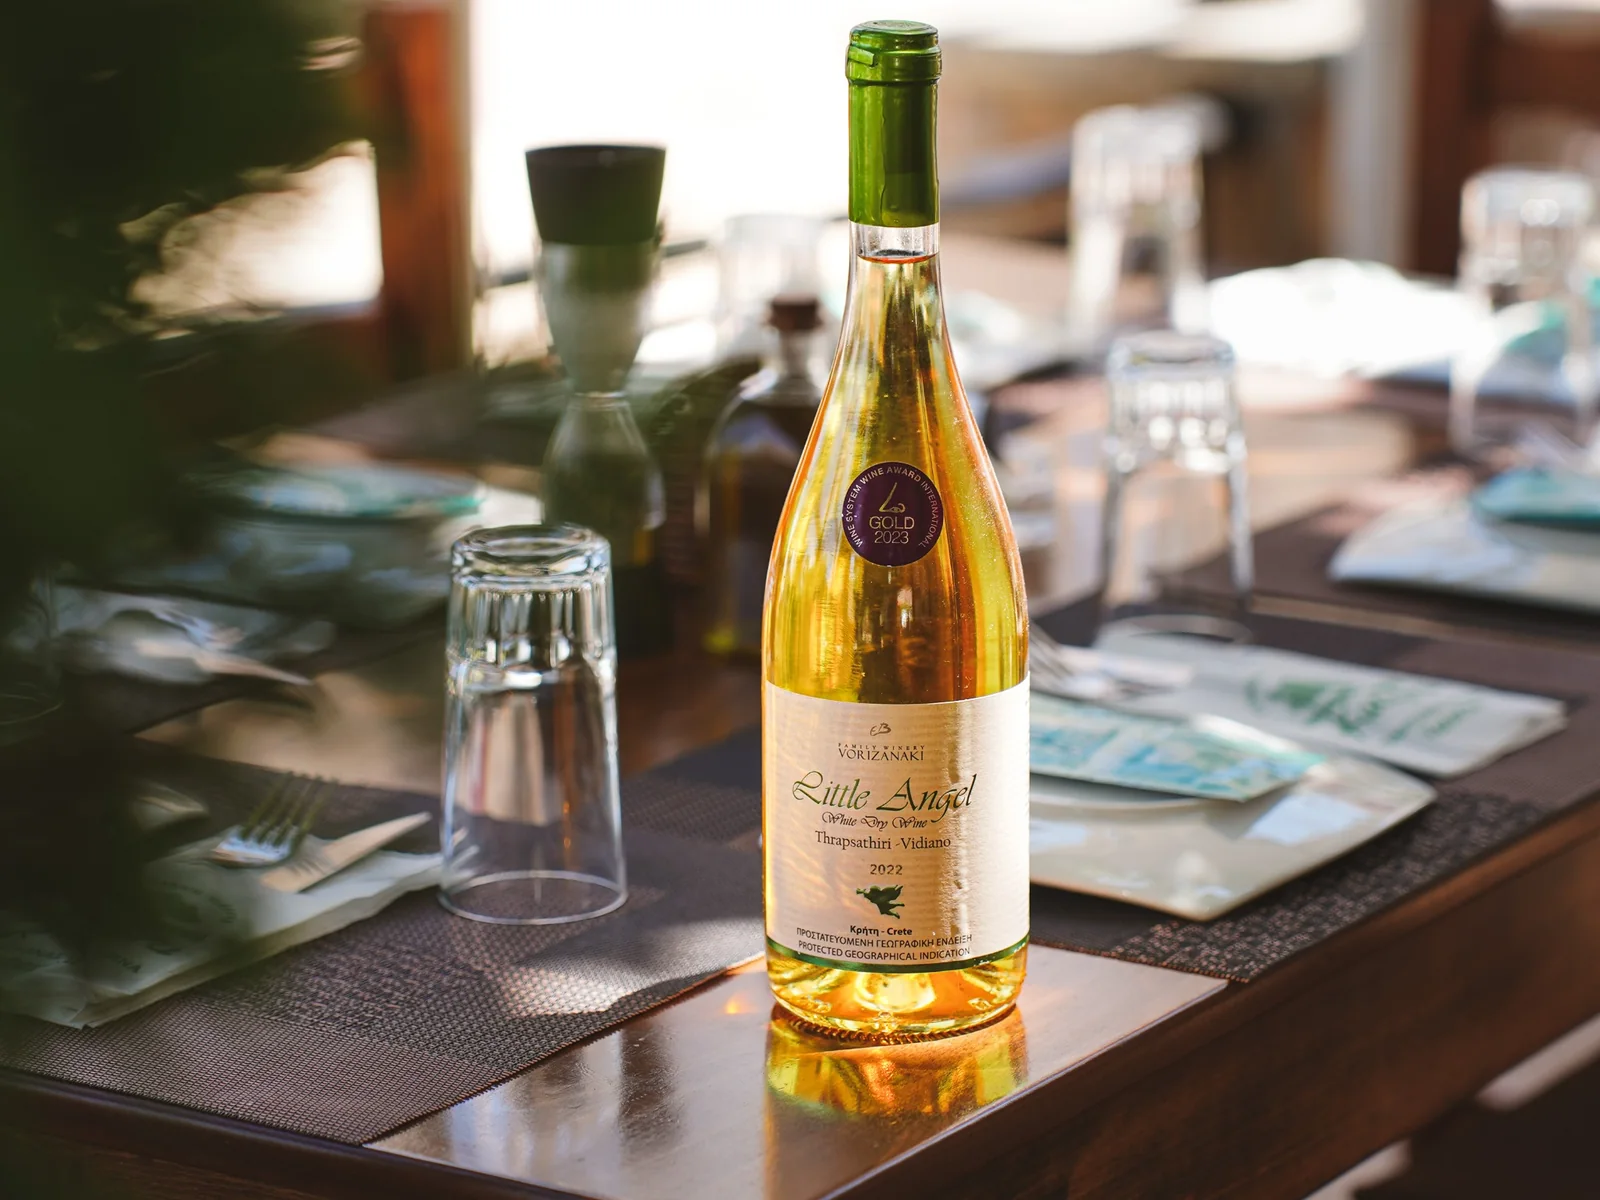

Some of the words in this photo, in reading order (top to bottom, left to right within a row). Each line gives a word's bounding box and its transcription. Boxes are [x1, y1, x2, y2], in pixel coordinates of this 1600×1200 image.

[860, 467, 884, 485] WINE
[886, 466, 921, 482] AWARD
[846, 484, 862, 522] SYSTEM
[869, 515, 915, 529] GOLD
[918, 480, 939, 548] INTERNATIONAL
[847, 524, 863, 547] WINE
[874, 530, 909, 544] 2023
[838, 742, 877, 750] FAMILY
[838, 748, 924, 762] VORIZANAKI
[792, 770, 871, 810] Little
[876, 773, 977, 823] Angel
[822, 811, 857, 827] White
[860, 815, 888, 832] Dry
[891, 816, 928, 829] Wine
[815, 830, 892, 850] Thrapsathiri
[900, 836, 951, 850] Vidiano
[870, 864, 903, 875] 2022
[796, 927, 874, 947] ΠΡΟΣΤΑΤΕΥΟΜΕΝΗ
[876, 937, 934, 948] ΓΕΩΓΡΑΦΙΚΗ
[850, 925, 880, 937] Κρήτη
[887, 927, 913, 936] Crete
[798, 940, 843, 957] PROTECTED
[845, 949, 918, 961] GEOGRAPHICAL
[919, 947, 971, 960] INDICATION
